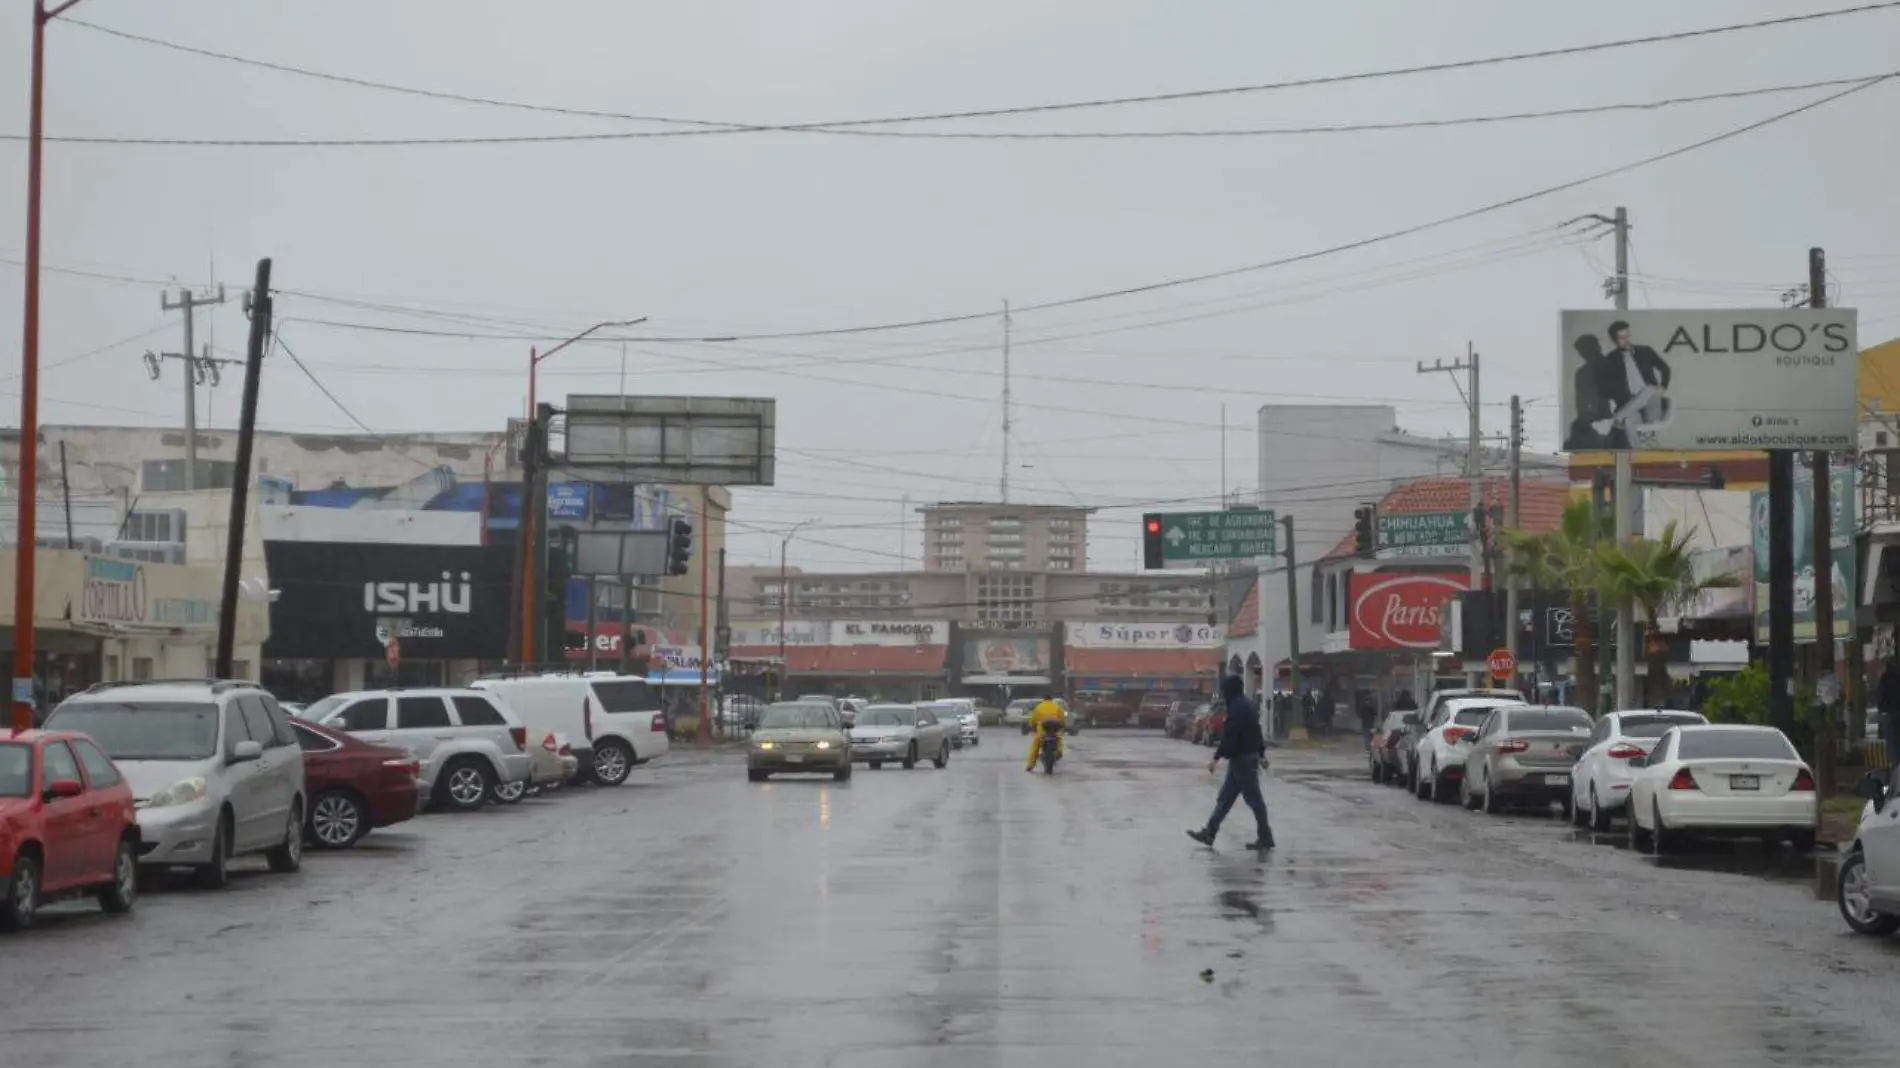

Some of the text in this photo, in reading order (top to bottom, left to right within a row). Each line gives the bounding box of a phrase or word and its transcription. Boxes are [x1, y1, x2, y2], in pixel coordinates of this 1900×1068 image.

[1776, 356, 1835, 367] BOUTIQUE
[1696, 433, 1849, 446] www.aldosboutique.com
[1209, 515, 1219, 527] DE
[1379, 516, 1455, 530] CHIHUAHUA
[1189, 543, 1232, 555] MERCADO
[364, 571, 471, 613] ISHÜ
[845, 623, 933, 636] EL FAMOSO
[1100, 626, 1169, 642] Súper
[1491, 661, 1514, 670] ALTO
